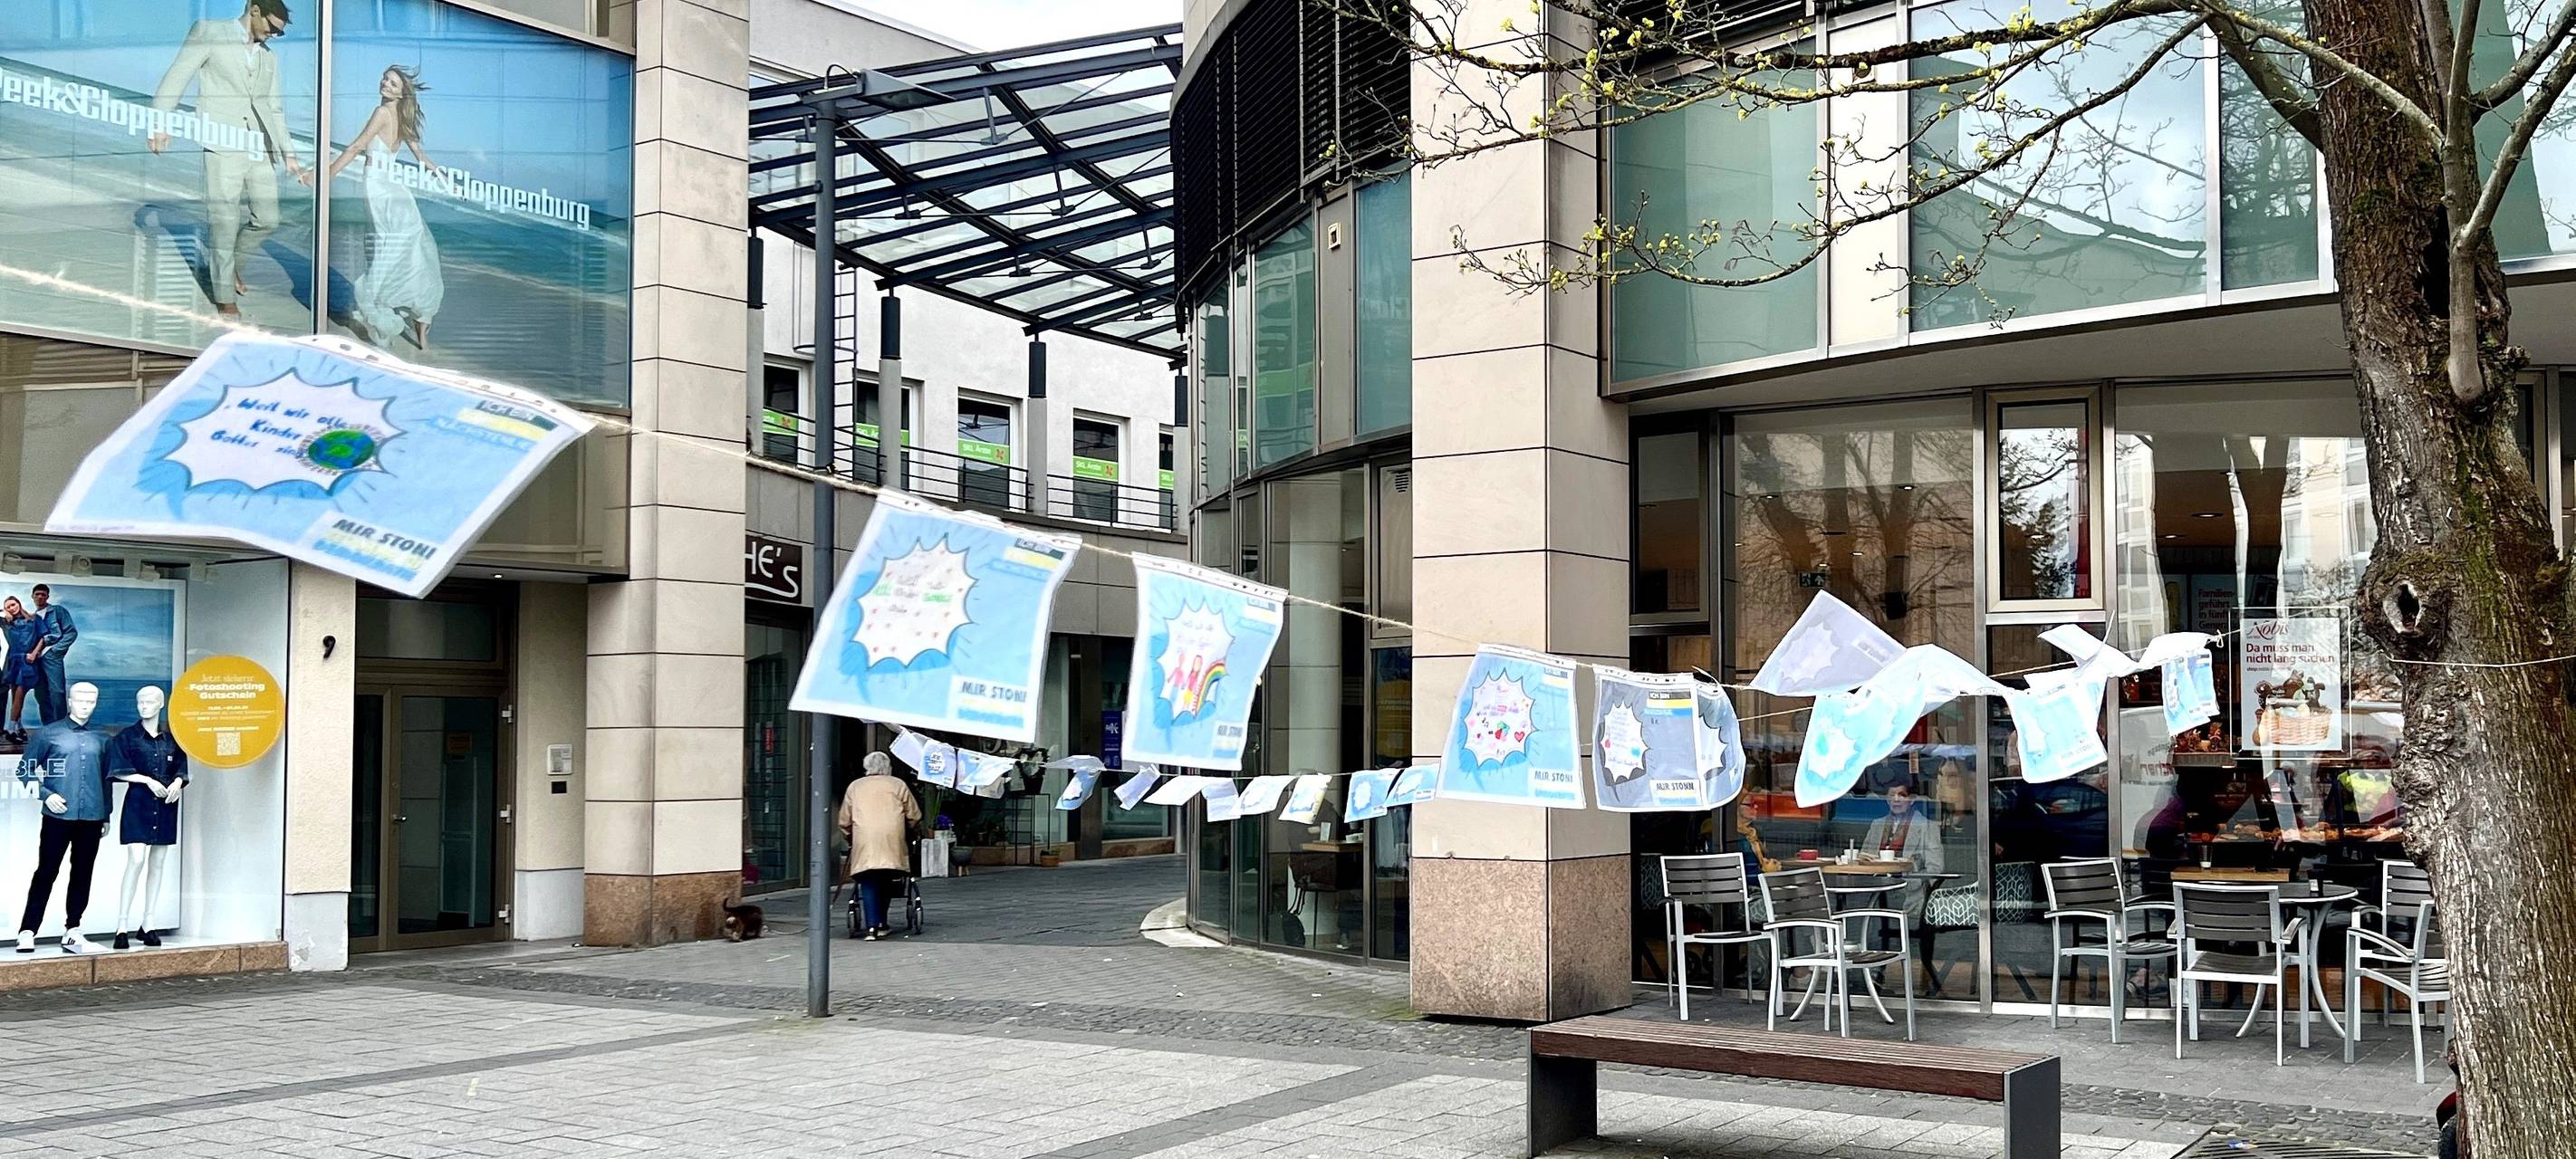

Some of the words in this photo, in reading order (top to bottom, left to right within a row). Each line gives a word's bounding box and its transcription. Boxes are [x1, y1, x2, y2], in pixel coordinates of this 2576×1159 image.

[0, 66, 264, 161] eek&Cloppenburg
[369, 151, 591, 231] Peek&Cloppenburg
[249, 418, 303, 440] Kinder
[332, 519, 376, 539] MIR
[2246, 620, 2290, 640] Nobis
[322, 634, 337, 660] 9
[2246, 644, 2260, 652] Da
[2246, 653, 2272, 663] nicht
[2273, 653, 2296, 666] lang
[188, 683, 265, 691] Fotoshooting
[962, 681, 987, 697] MIR
[1534, 770, 1550, 781] MIR
[1656, 781, 1670, 790] MIR
